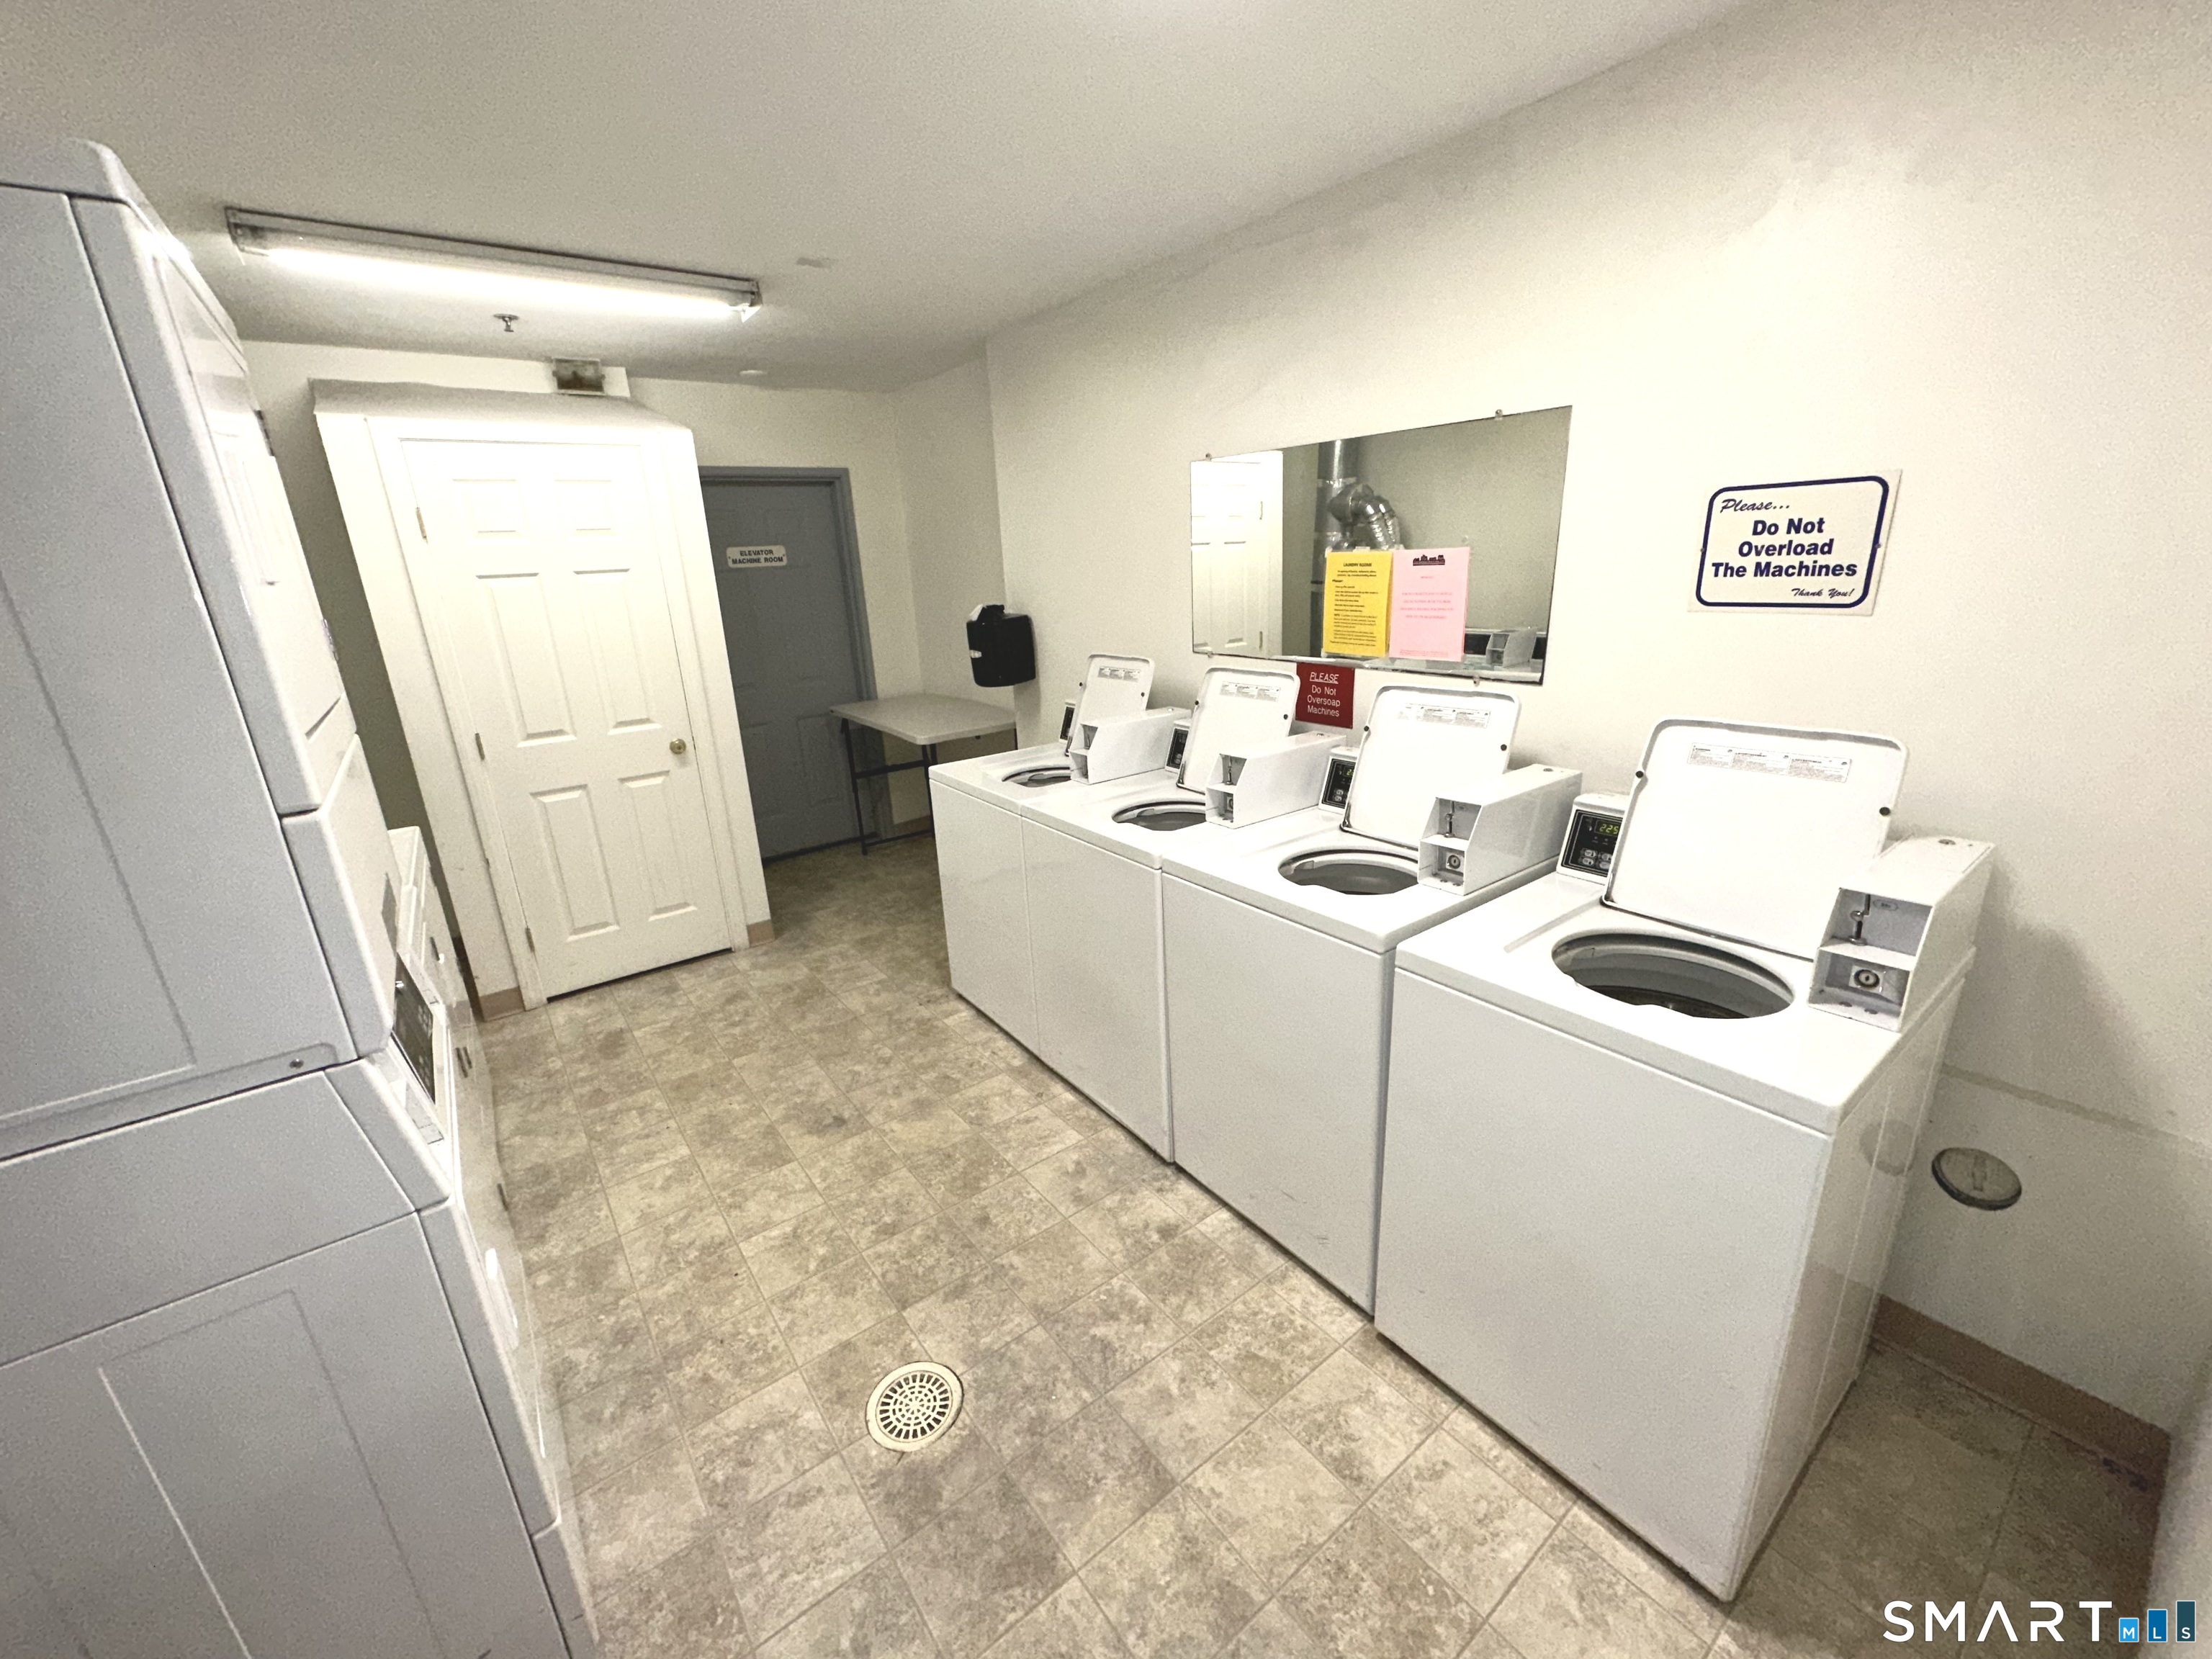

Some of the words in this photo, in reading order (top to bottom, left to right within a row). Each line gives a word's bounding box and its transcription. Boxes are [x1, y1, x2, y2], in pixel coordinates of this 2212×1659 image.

[1719, 498, 1789, 513] Please...
[1752, 520, 1779, 536] Do
[1786, 518, 1825, 534] Not
[1738, 539, 1835, 557] Overload
[1712, 562, 1747, 577] The
[1753, 560, 1858, 577] Machines
[1791, 588, 1823, 597] Thank
[1827, 588, 1855, 598] You!
[1310, 672, 1339, 683] PLEASE
[1312, 685, 1321, 693] Do
[1325, 686, 1336, 696] Not
[1307, 695, 1341, 707] Oversoap
[1308, 705, 1340, 717] Machines
